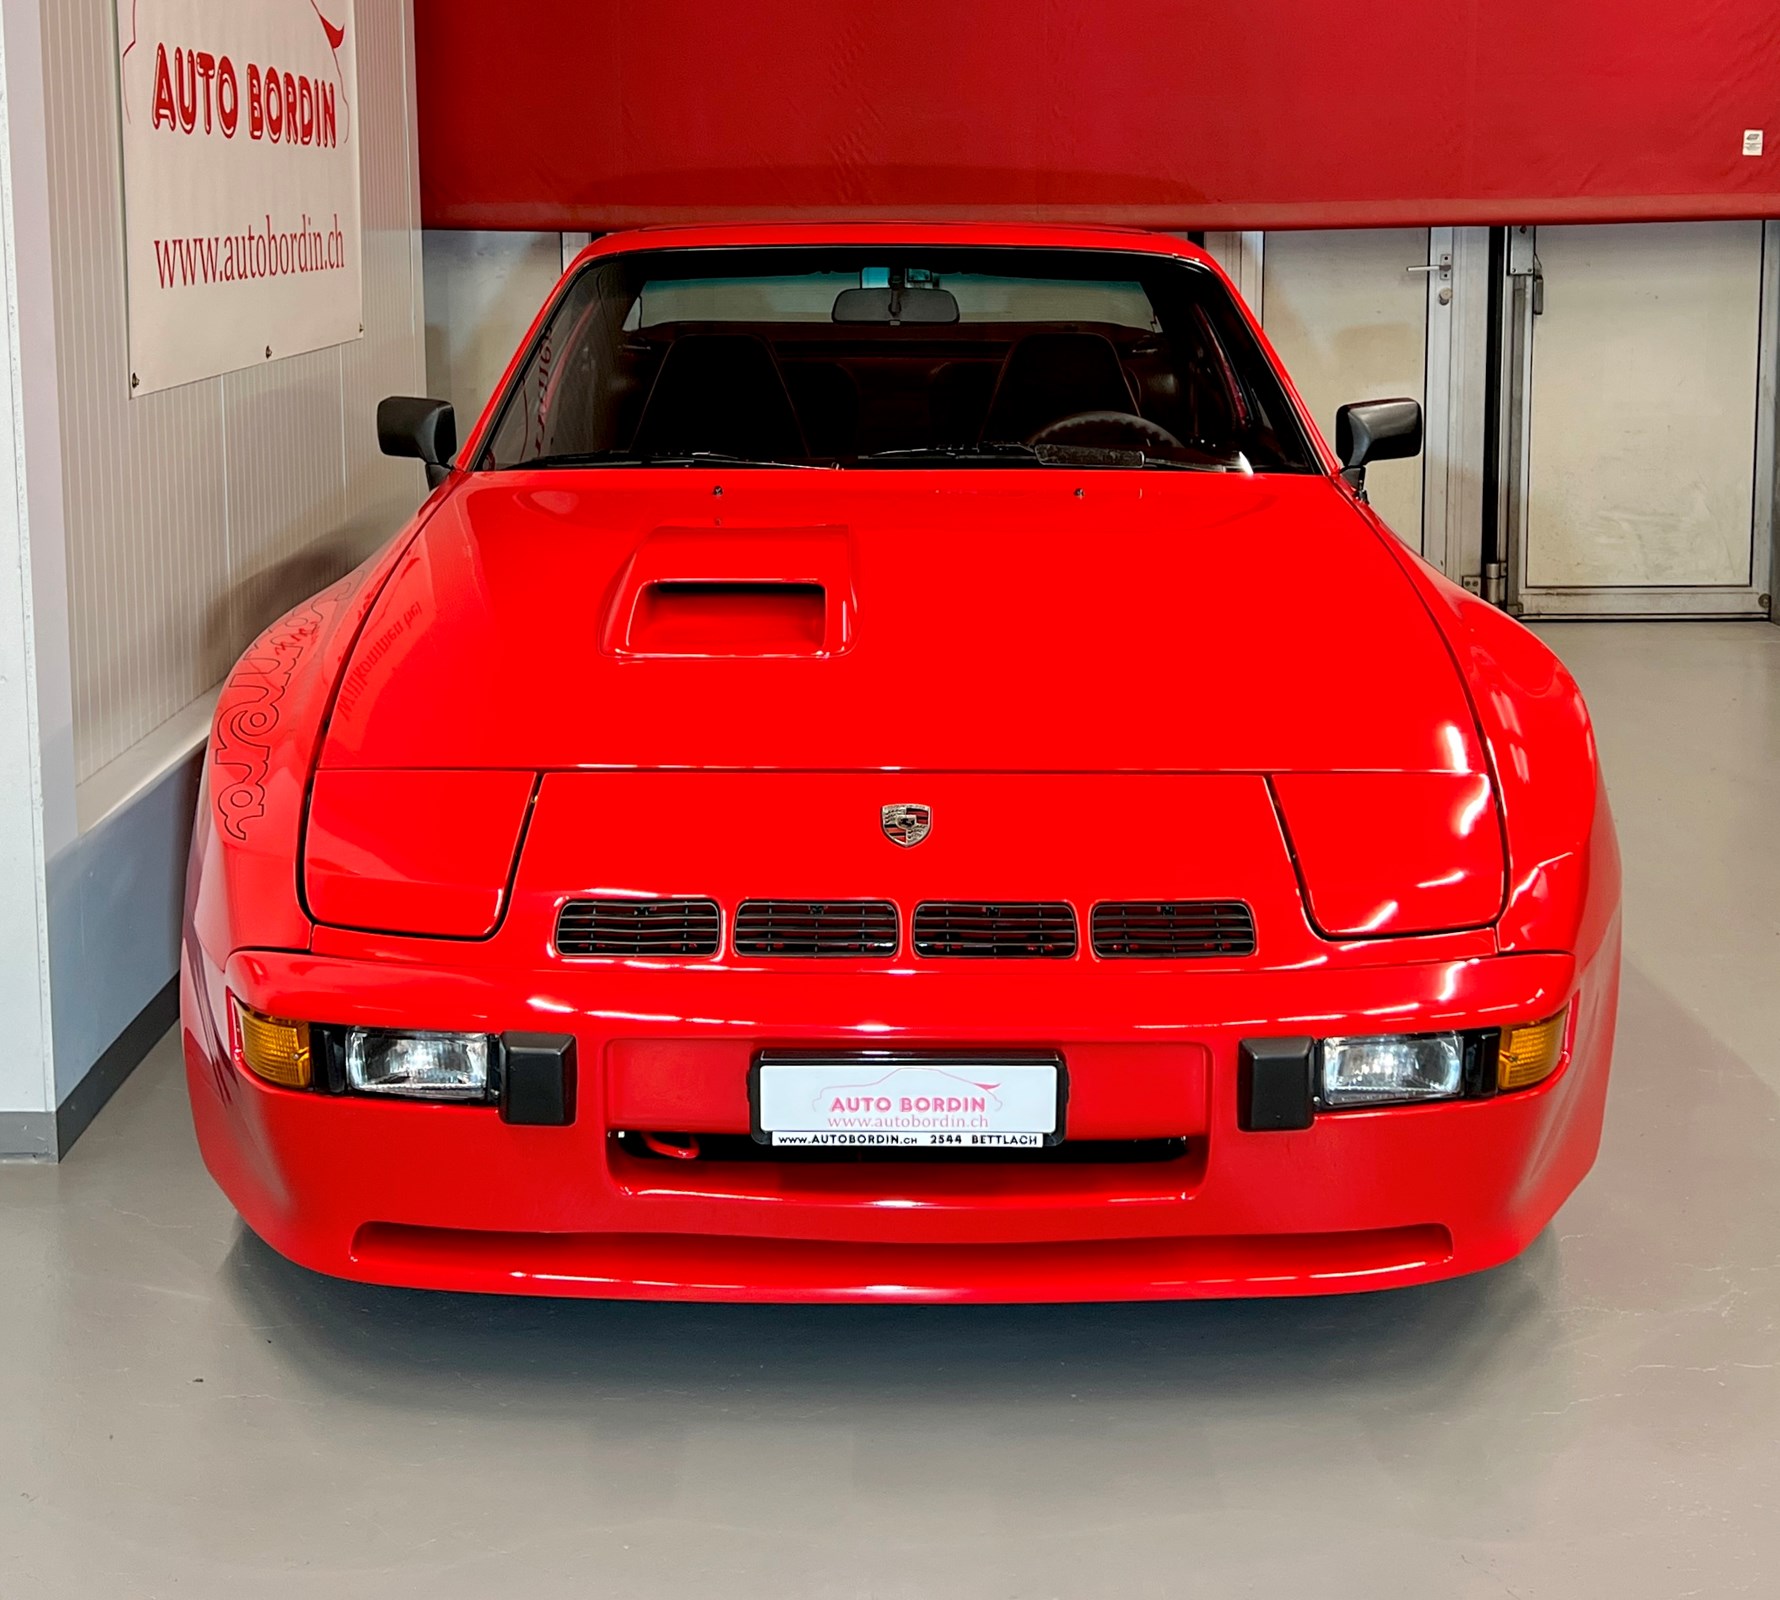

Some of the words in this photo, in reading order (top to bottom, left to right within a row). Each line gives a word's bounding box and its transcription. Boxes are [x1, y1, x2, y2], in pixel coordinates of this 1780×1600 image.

[152, 42, 239, 139] AUTO
[246, 63, 337, 149] BORDIN
[154, 213, 345, 289] www.autobordin.ch
[829, 1097, 892, 1113] AUTO
[900, 1097, 986, 1113] BORDIN
[827, 1114, 989, 1129] www.autobordin.ch
[930, 1134, 962, 1145] 2544
[972, 1135, 1038, 1146] BETTLACH
